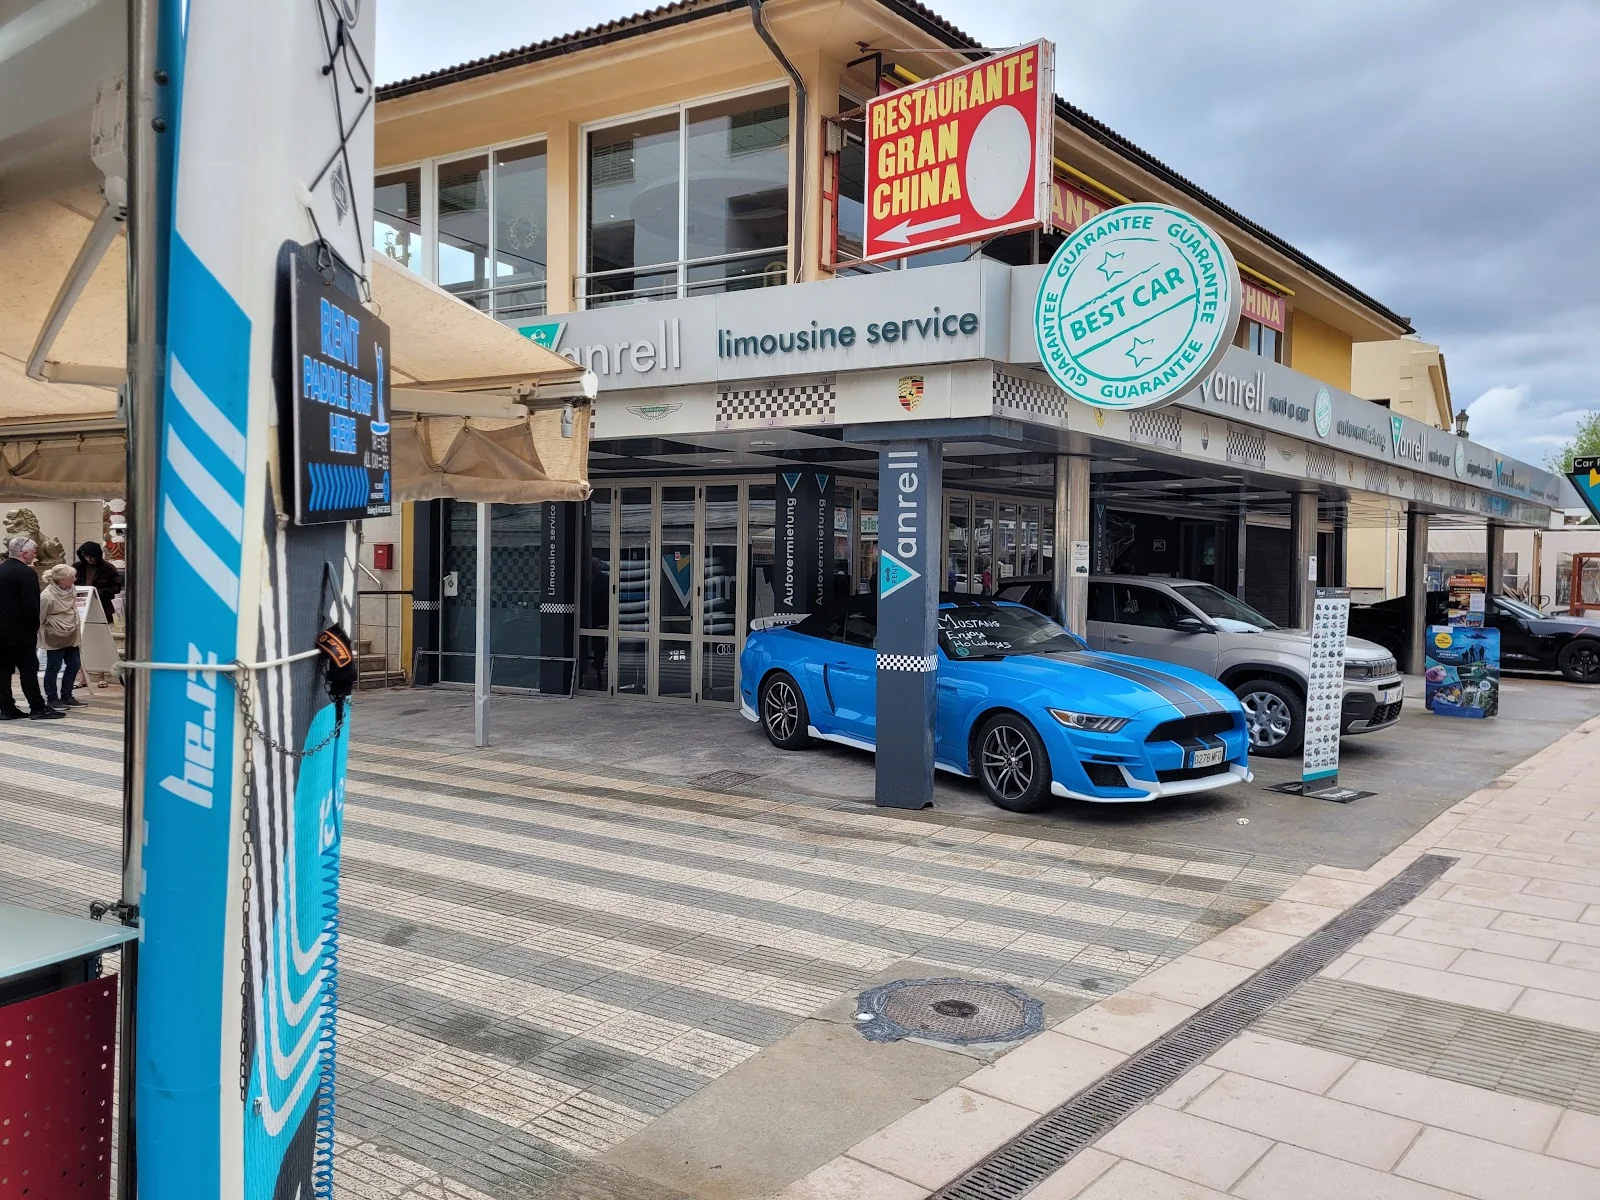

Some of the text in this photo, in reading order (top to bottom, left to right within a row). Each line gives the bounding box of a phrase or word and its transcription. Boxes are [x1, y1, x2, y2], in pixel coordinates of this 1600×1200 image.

[872, 50, 1034, 140] RESTAURANTE
[878, 120, 959, 180] GRAN
[872, 163, 961, 221] CHINA
[1057, 216, 1154, 278] GUARANTEE
[1167, 223, 1218, 324] GUARANTEE
[320, 296, 360, 370] RENT
[717, 306, 979, 359] limousine service
[1043, 291, 1088, 387] GUARANTEE
[1069, 268, 1185, 341] BEST CAR
[303, 354, 373, 417] PADDLE SURF
[1100, 339, 1203, 398] GUARANTEE
[329, 411, 357, 454] HERE
[1574, 458, 1594, 468] Car
[548, 504, 556, 596] Limousine service
[783, 497, 797, 607] Autovermietung
[815, 499, 827, 606] Autovermietung
[880, 451, 922, 600] Vanrell
[159, 641, 217, 809] zray
[1194, 753, 1211, 765] 0276
